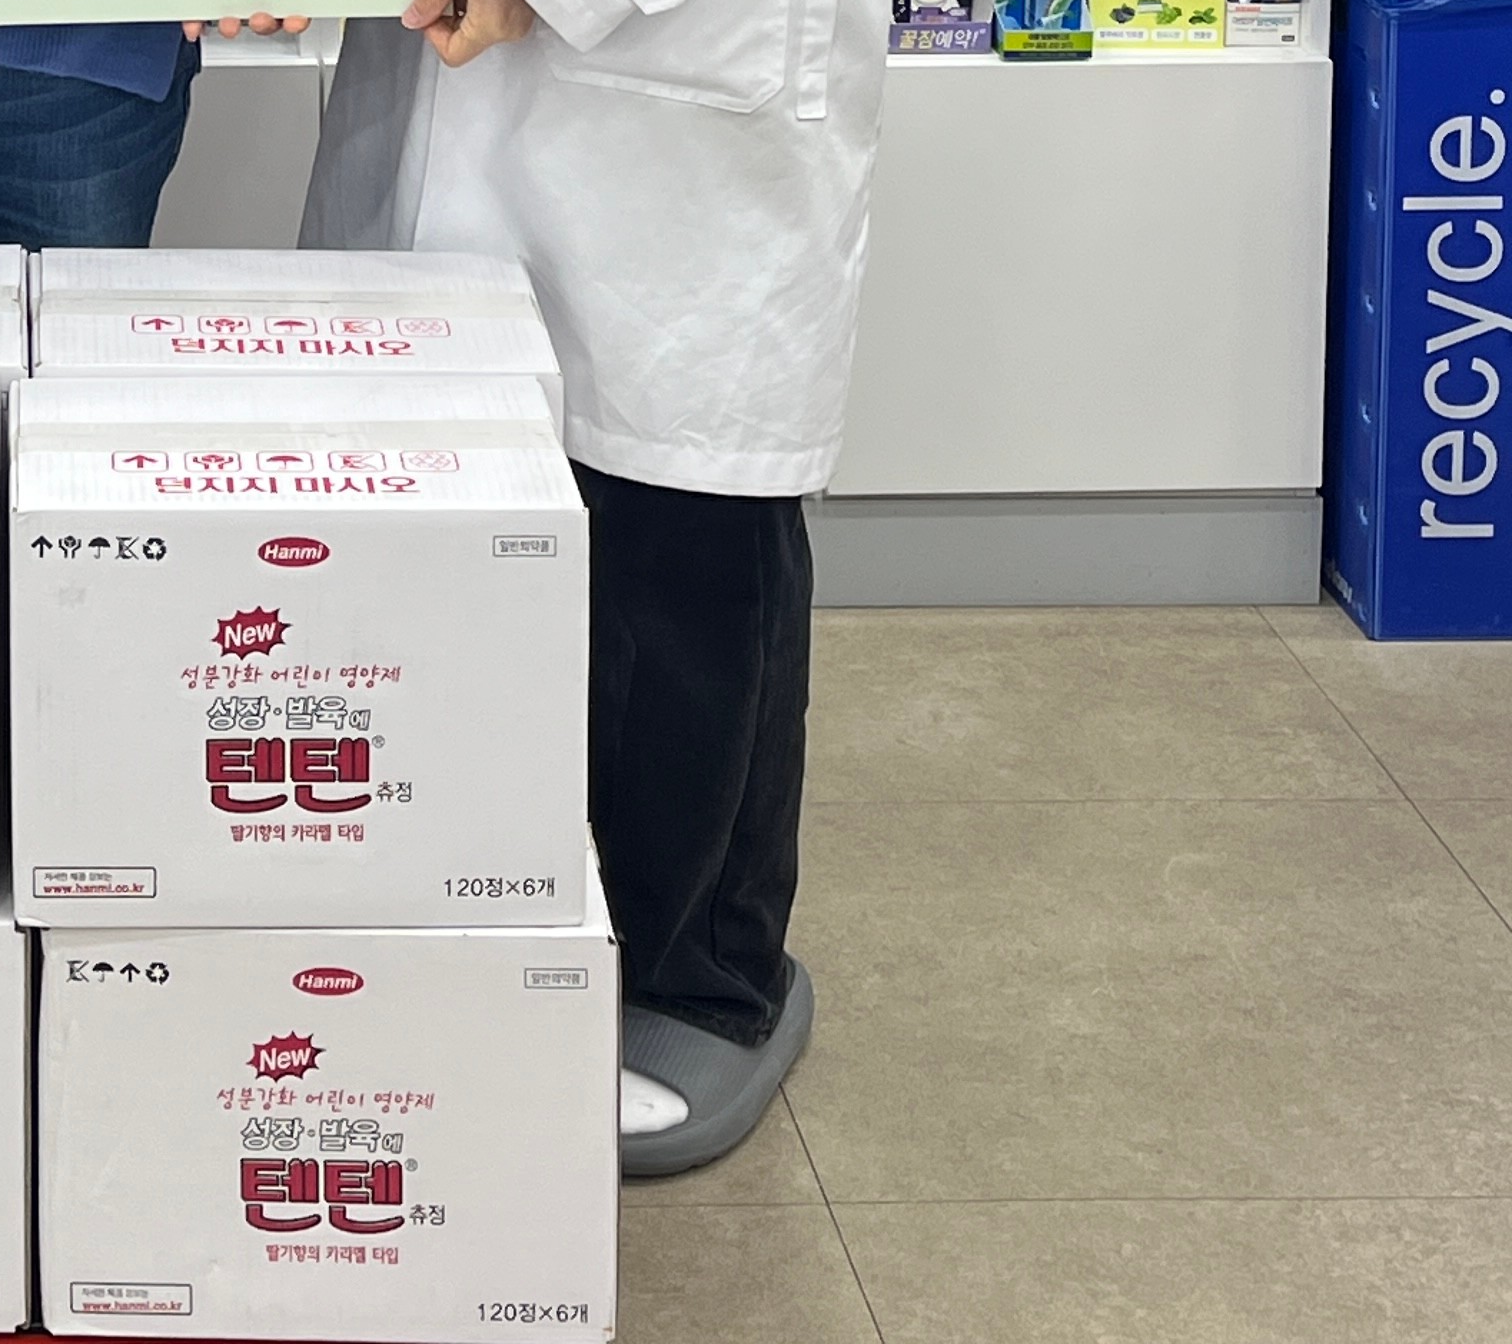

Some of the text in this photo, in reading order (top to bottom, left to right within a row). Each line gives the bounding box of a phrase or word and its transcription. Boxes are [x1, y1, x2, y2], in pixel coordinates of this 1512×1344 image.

[899, 29, 979, 49] 꿀잠예약!
[1402, 88, 1512, 539] recycle.
[171, 336, 415, 357] 던지지 마시오
[154, 475, 421, 495] 던지지 마시오
[263, 542, 323, 562] Hanmi
[223, 620, 277, 649] New
[181, 664, 401, 689] 성분강화 어린이 영양제
[376, 781, 413, 803] 츄정
[230, 823, 287, 843] 딸기향의
[337, 823, 366, 842] 타입
[43, 882, 145, 896] www.hanmi.co.kr
[298, 972, 359, 992] Hanmi
[259, 1045, 311, 1072] New
[217, 1088, 435, 1113] 성분강화 어린이 영양제
[409, 1203, 446, 1226] 츄정
[265, 1243, 320, 1264] 딸기향의
[371, 1244, 399, 1265] 타입
